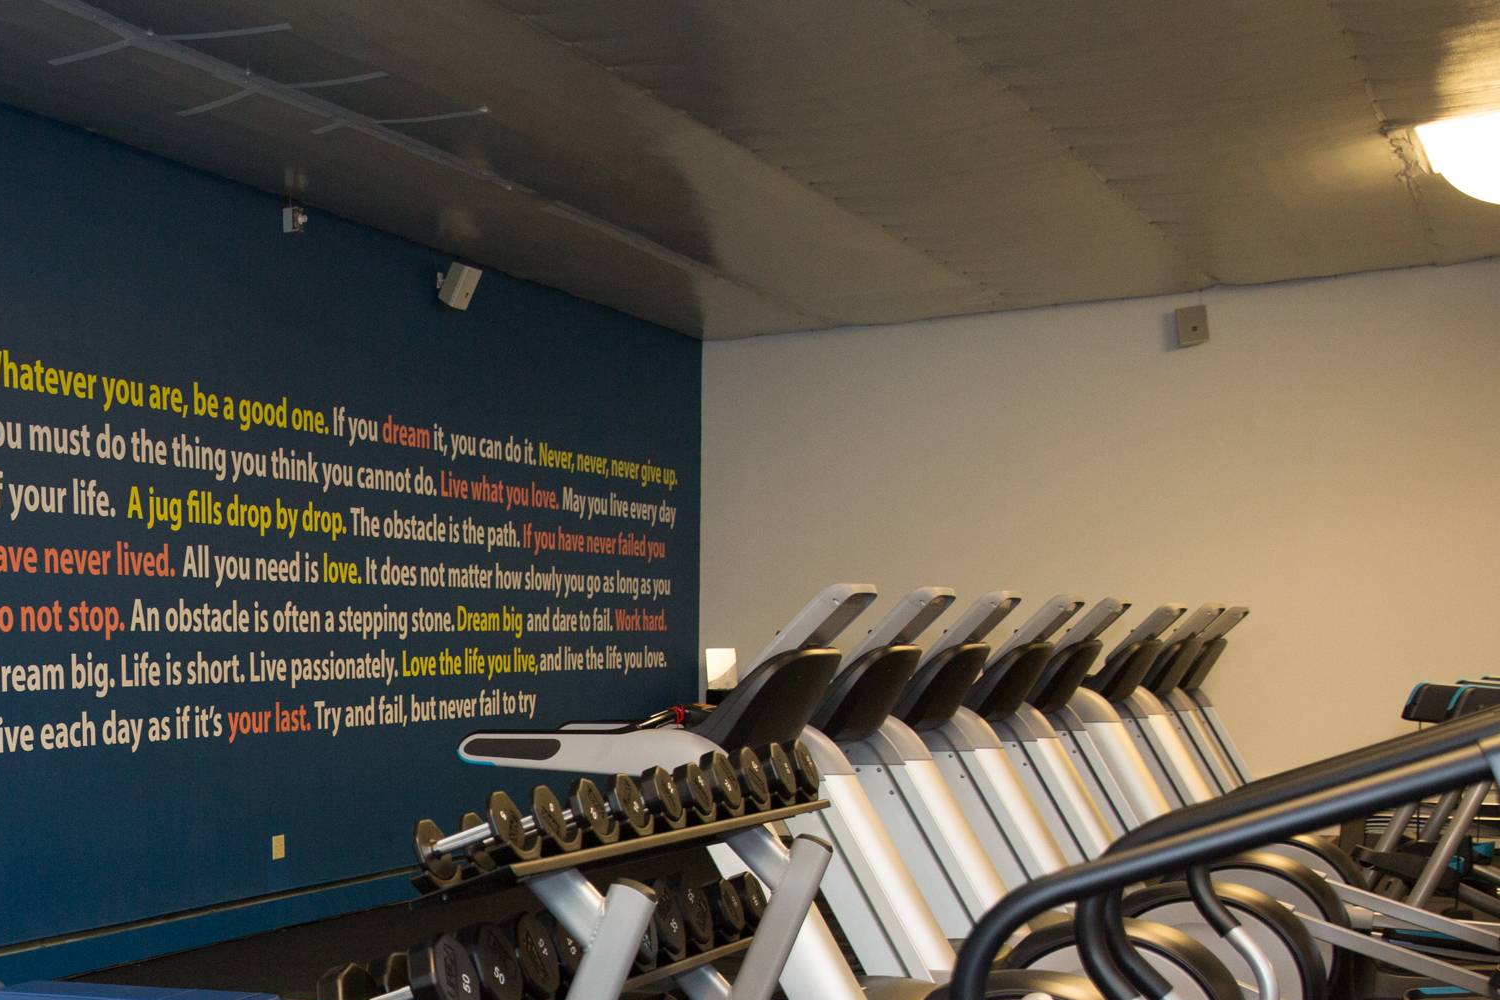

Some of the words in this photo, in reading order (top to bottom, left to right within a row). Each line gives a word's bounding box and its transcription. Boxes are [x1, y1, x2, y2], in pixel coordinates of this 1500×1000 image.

[101, 376, 144, 412] you
[148, 384, 189, 419] are,
[193, 381, 219, 418] be
[222, 396, 235, 421] a
[238, 396, 288, 432] good
[291, 407, 330, 435] one.
[332, 406, 346, 437] If
[347, 416, 379, 447] you
[382, 414, 431, 449] dream
[433, 422, 448, 457] it,
[450, 433, 477, 461] you
[478, 437, 503, 461] can
[504, 435, 522, 464] do
[524, 438, 537, 466] it.
[538, 442, 575, 473] Never,
[576, 453, 610, 478] never,
[611, 459, 640, 480] never
[640, 459, 662, 488] give
[663, 468, 678, 491] up.
[28, 424, 91, 457] must
[95, 423, 127, 461] do
[130, 427, 168, 466] the
[171, 433, 227, 482] thing
[230, 450, 267, 483] you
[270, 447, 319, 484] think
[321, 462, 354, 493] you
[356, 466, 412, 494] cannot
[413, 465, 438, 497] do.
[440, 470, 469, 500] Live
[470, 475, 504, 504] what
[505, 485, 529, 511] you
[531, 481, 559, 510] love.
[562, 486, 586, 520] May
[587, 496, 608, 521] you
[610, 492, 629, 518] live
[630, 501, 658, 527] every
[658, 499, 677, 529] day
[8, 483, 68, 521] your
[72, 478, 117, 518] life.
[127, 485, 144, 520] A
[146, 486, 183, 532] jug
[186, 489, 223, 526] fills
[226, 493, 272, 537] drop
[275, 497, 299, 539] by
[301, 500, 347, 542] drop.
[349, 506, 381, 538] The
[383, 509, 446, 543] obstacle
[448, 515, 460, 544] is
[461, 516, 485, 545] the
[487, 520, 521, 553] path.
[523, 522, 533, 548] If
[534, 531, 556, 556] you
[558, 526, 585, 553] have
[586, 535, 617, 555] never
[617, 532, 647, 557] failed
[647, 541, 666, 562] you
[43, 547, 112, 576] never
[116, 540, 176, 578] lived.
[182, 544, 210, 579] All
[213, 555, 251, 588] you
[255, 550, 301, 583] need
[304, 551, 319, 584] is
[323, 552, 362, 585] love.
[365, 556, 378, 585] It
[380, 555, 418, 587] does
[420, 562, 446, 588] not
[448, 564, 493, 589] matter
[495, 562, 523, 590] how
[524, 564, 563, 598] slowly
[563, 573, 585, 599] you
[586, 575, 601, 599] go
[602, 575, 615, 594] as
[616, 570, 639, 601] long
[640, 577, 652, 595] as
[652, 578, 671, 601] you
[20, 599, 64, 633] not
[67, 600, 126, 641] stop.
[130, 598, 160, 632] An
[165, 597, 250, 633] obstacle
[253, 600, 269, 633] is
[272, 600, 321, 633] often
[324, 610, 335, 633] a
[338, 603, 408, 641] stepping
[411, 607, 455, 633] stone.
[457, 605, 501, 632] Dream
[502, 605, 523, 639] big
[526, 606, 550, 632] and
[552, 606, 578, 632] dare
[578, 610, 591, 632] to
[592, 607, 614, 632] fail.
[615, 607, 642, 631] Work
[642, 608, 668, 632] hard.
[70, 651, 116, 698] big.
[120, 651, 161, 688] Life
[165, 651, 183, 686] is
[186, 650, 246, 686] short.
[249, 650, 287, 683] Live
[290, 648, 399, 689] passionately.
[402, 650, 437, 677] Love
[438, 647, 462, 676] the
[464, 647, 485, 675] life
[487, 654, 511, 681] you
[513, 646, 539, 676] live,
[539, 645, 562, 672] and
[564, 645, 584, 671] live
[585, 645, 605, 671] the
[605, 645, 623, 670] life
[623, 651, 643, 676] you
[644, 645, 667, 669] love.
[40, 710, 97, 751] each
[101, 709, 144, 754] day
[147, 716, 172, 743] as
[175, 704, 191, 740] if
[227, 710, 272, 744] your
[275, 701, 312, 733] last.
[313, 700, 342, 737] Try
[344, 695, 376, 728] and
[378, 694, 408, 728] fail,
[410, 693, 437, 723] but
[438, 697, 478, 720] never
[478, 688, 501, 717] fail
[502, 691, 517, 715] to
[517, 690, 537, 720] try
[461, 973, 471, 994] 50
[493, 966, 506, 985] 50
